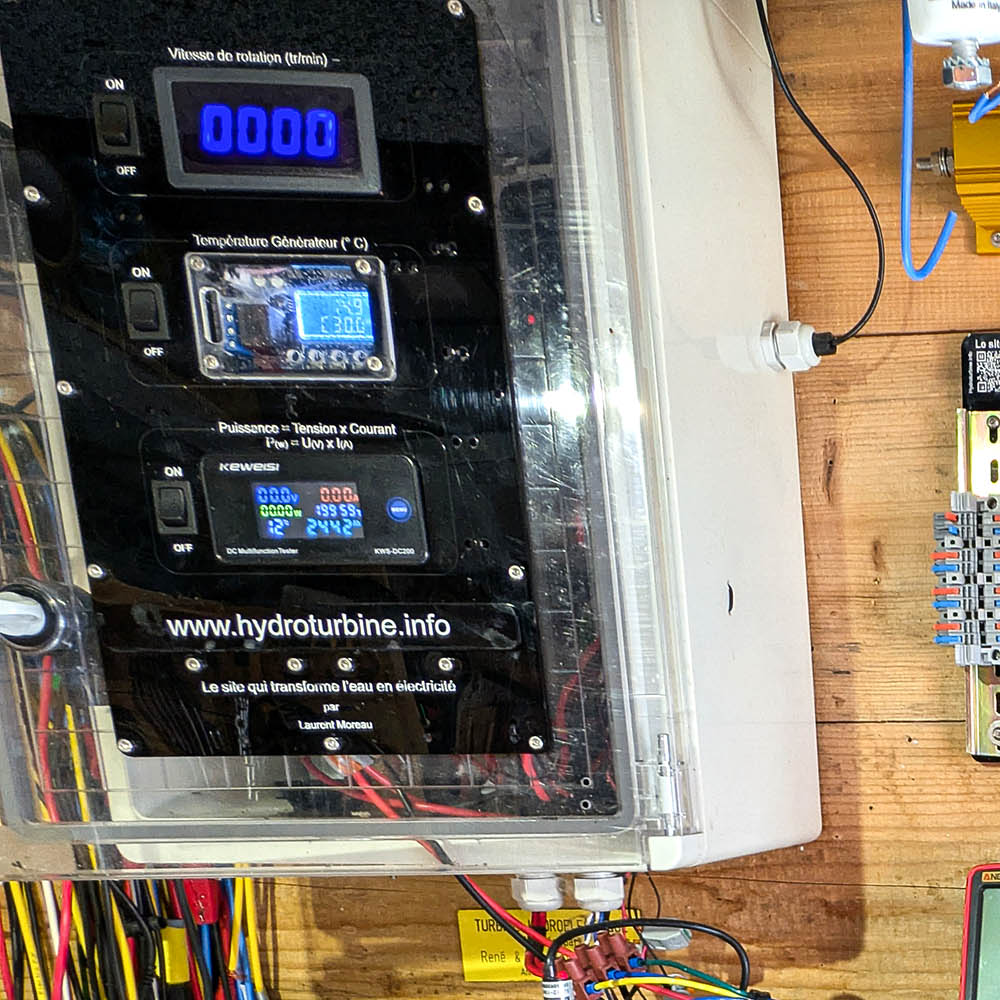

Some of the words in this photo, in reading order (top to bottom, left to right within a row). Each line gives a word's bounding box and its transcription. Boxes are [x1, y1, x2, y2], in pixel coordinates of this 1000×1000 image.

[167, 47, 214, 62] Vitesse
[217, 50, 233, 62] de
[236, 51, 282, 65] rotation
[284, 51, 328, 68] (tr/min)
[105, 78, 125, 90] ON
[201, 103, 338, 159] 0000
[116, 166, 137, 176] OFF
[131, 267, 152, 278] ON
[975, 338, 987, 349] Le
[143, 347, 164, 357] OFF
[218, 421, 280, 435] Puissance
[291, 422, 340, 435] Tension
[341, 425, 349, 435] x
[349, 423, 397, 435] Courant
[326, 439, 335, 449] x
[164, 466, 183, 478] ON
[172, 542, 194, 553] OFF
[166, 612, 451, 642] www.hydroturbine.info
[201, 680, 219, 694] Le
[221, 680, 245, 693] site
[247, 680, 269, 696] qui
[270, 680, 340, 693] transforme
[342, 680, 374, 693] l'eau
[375, 683, 394, 693] en
[395, 679, 457, 693] électricité
[323, 702, 340, 714] par
[298, 719, 335, 730] Laurent
[336, 719, 374, 730] Moreau
[480, 950, 506, 963] René
[515, 950, 521, 962] &
